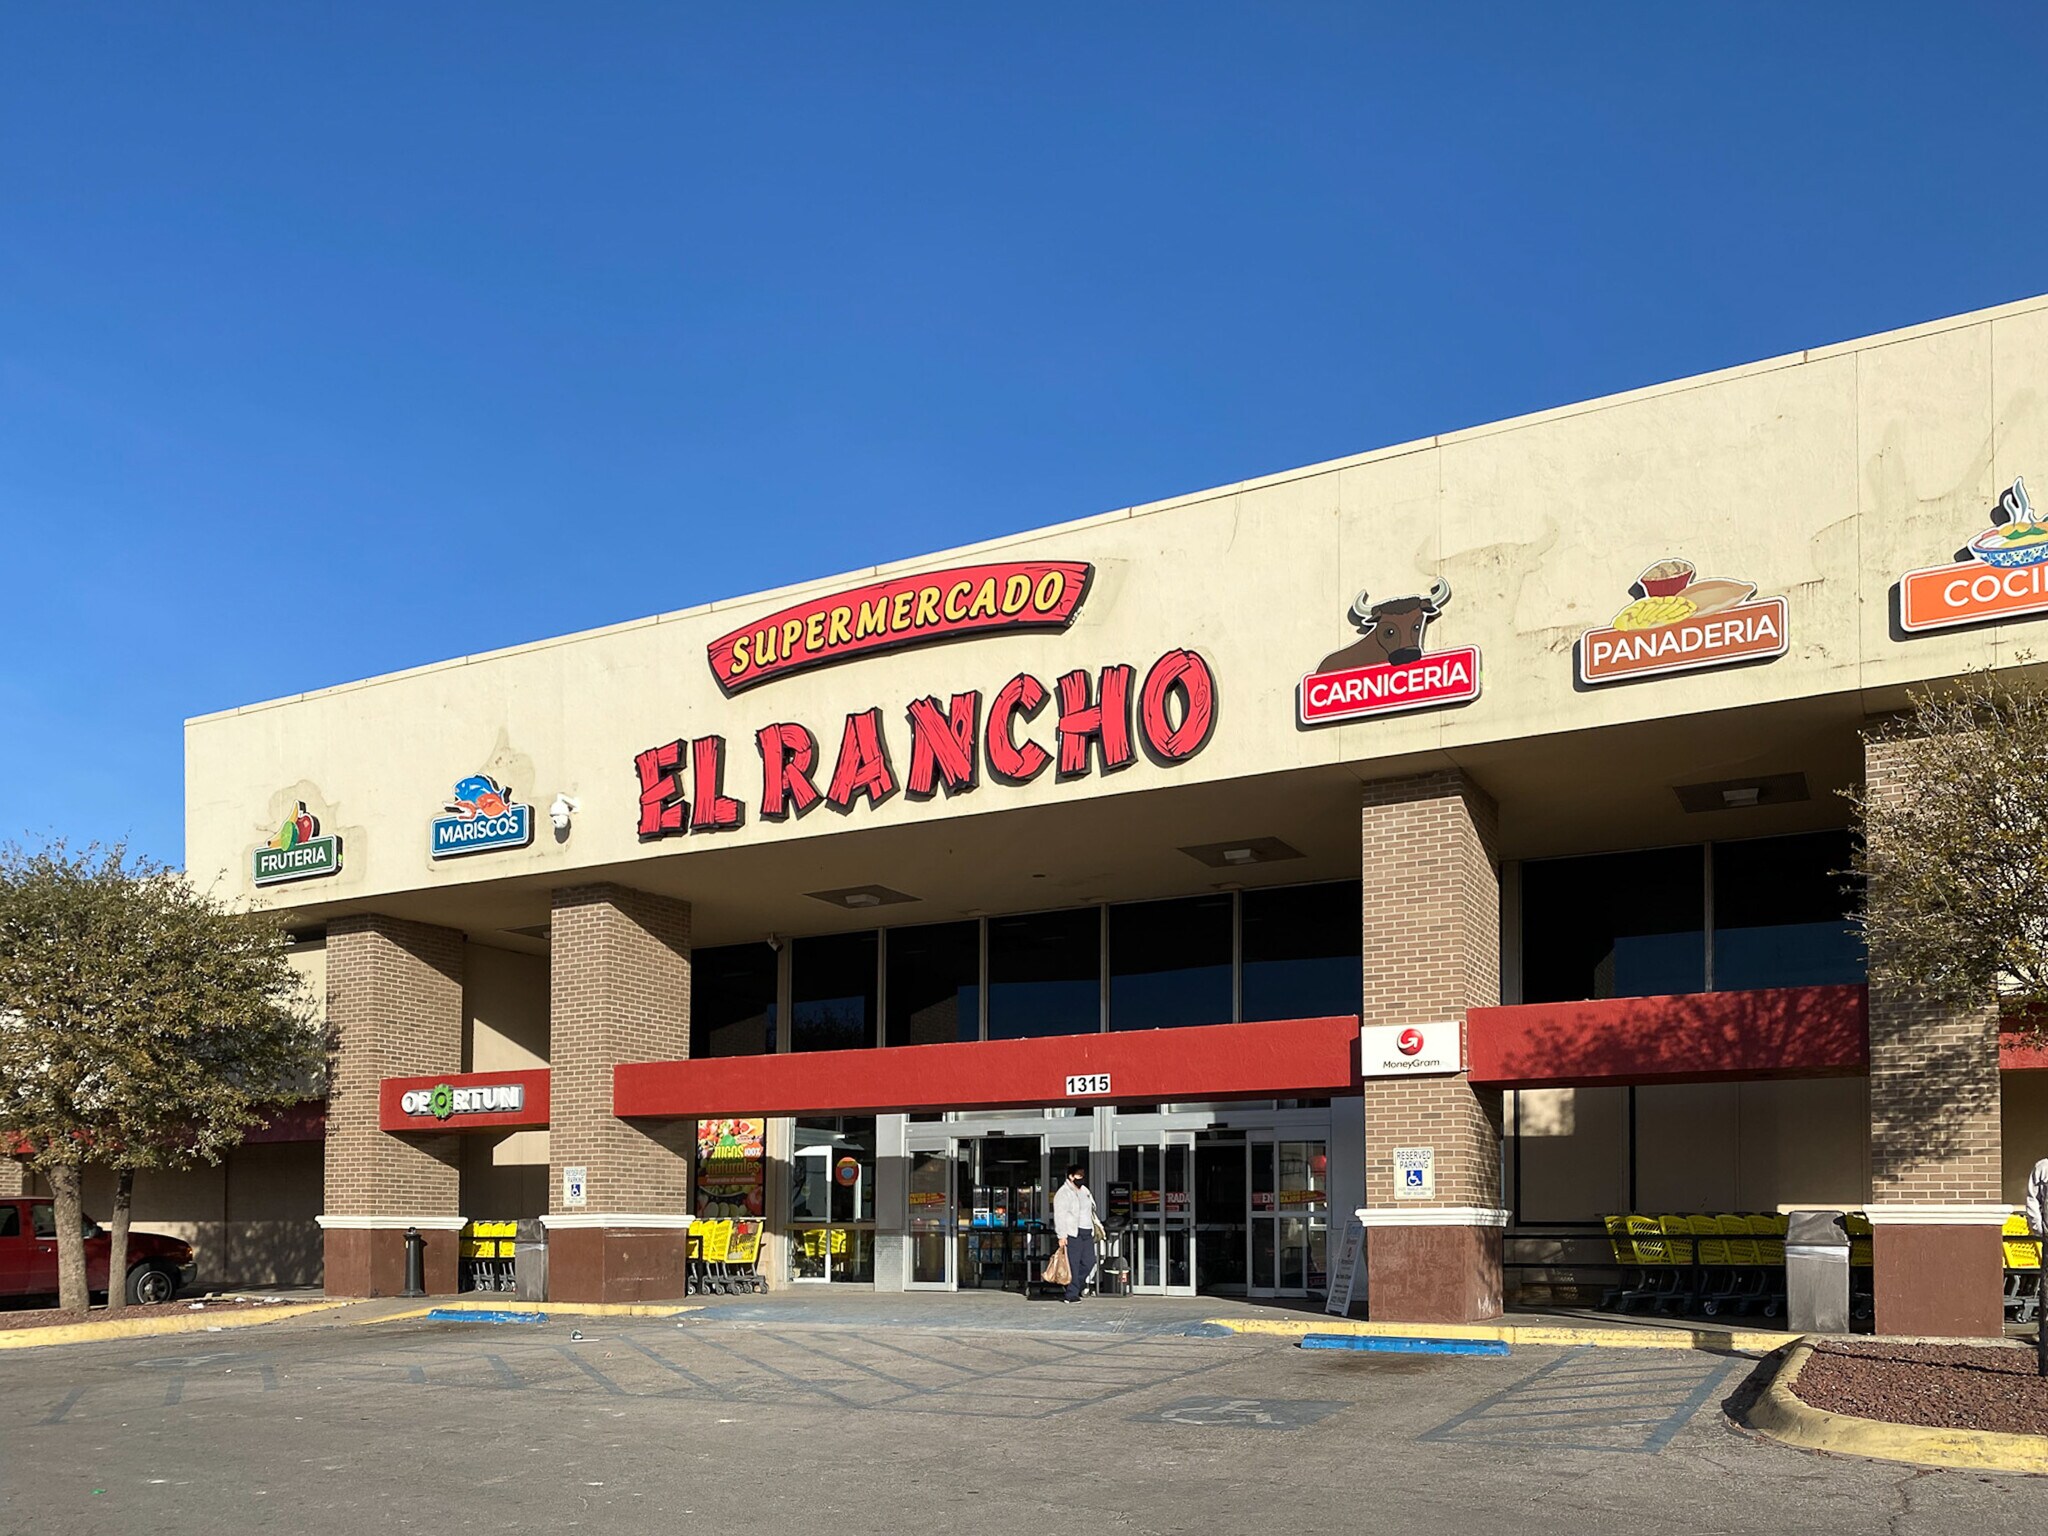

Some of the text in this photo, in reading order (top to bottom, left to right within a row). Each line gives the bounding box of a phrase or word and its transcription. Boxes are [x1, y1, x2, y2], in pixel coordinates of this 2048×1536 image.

[1943, 566, 2048, 607] COCI
[730, 570, 1065, 675] SUPERMERCADO
[1593, 615, 1778, 667] PANADERIA
[1309, 660, 1469, 707] CARNICERÍA
[634, 648, 1218, 842] EL RANCHO
[439, 816, 518, 844] MARISCOS
[260, 846, 327, 873] FRUTERIA
[1382, 1058, 1440, 1069] MoneyGram
[1067, 1075, 1109, 1093] 1315
[401, 1084, 521, 1118] OPORTUN
[1397, 1150, 1431, 1159] RESERVED
[1399, 1160, 1429, 1169] PARKING
